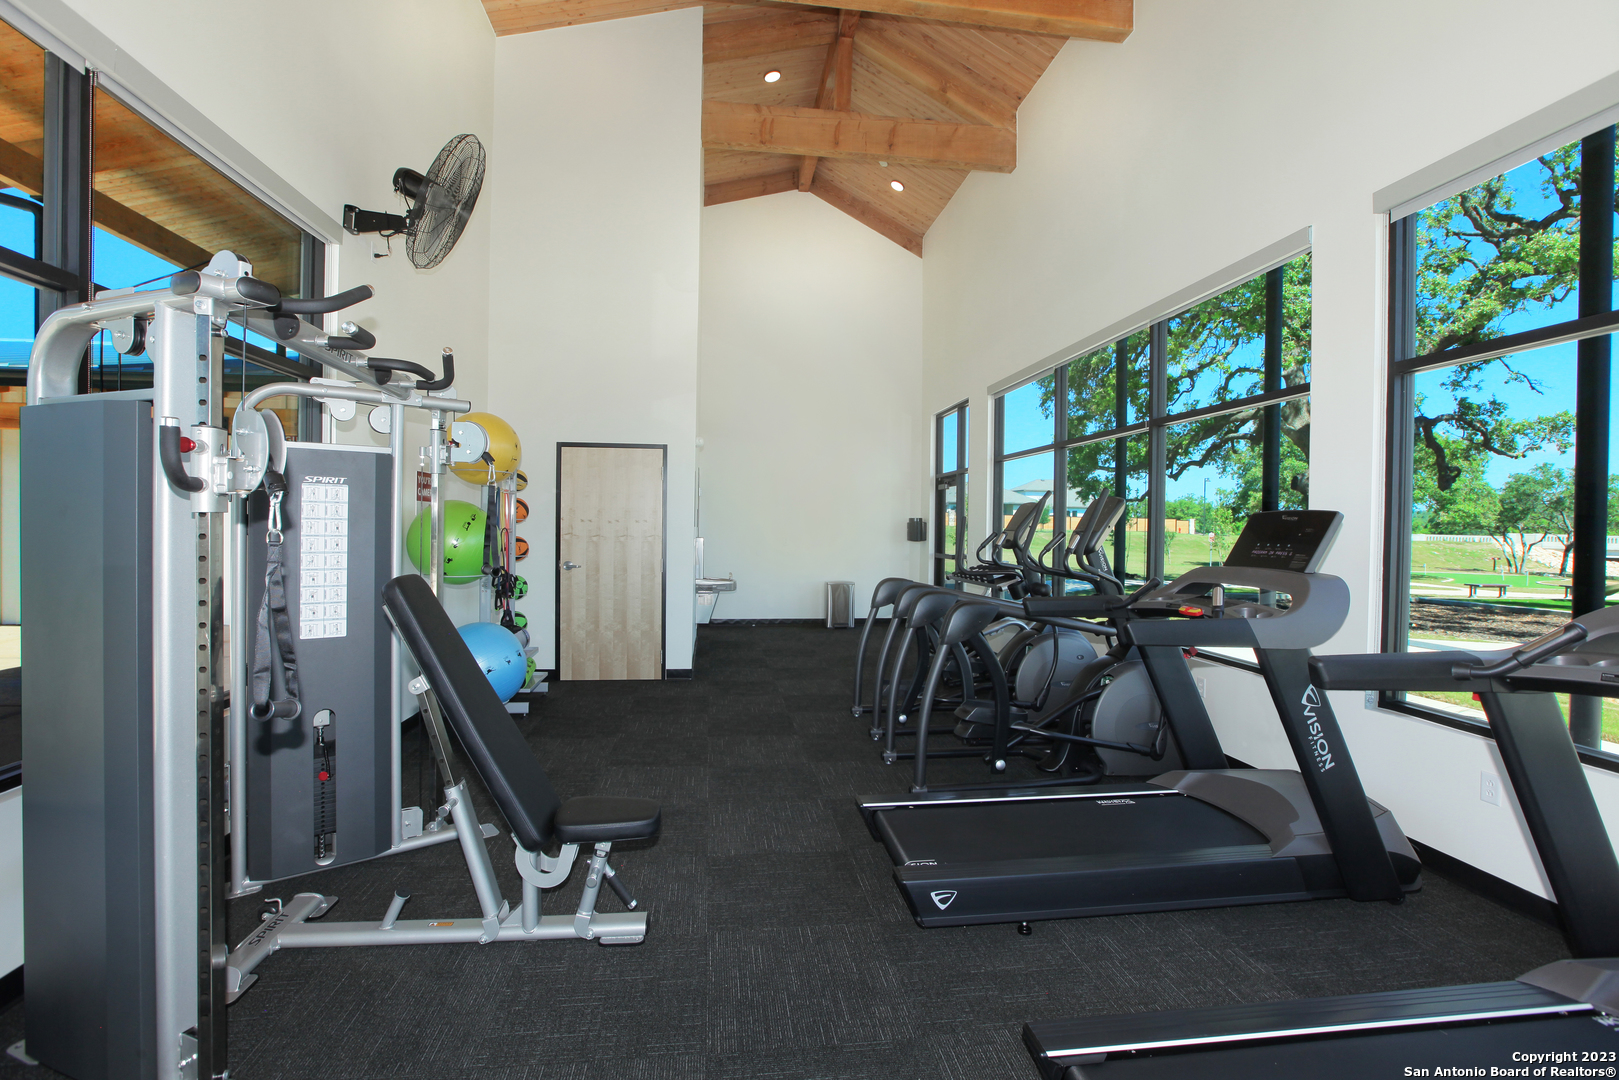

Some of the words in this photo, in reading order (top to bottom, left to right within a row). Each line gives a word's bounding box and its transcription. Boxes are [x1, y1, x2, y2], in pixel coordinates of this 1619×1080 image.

[325, 347, 353, 363] SPIRIT
[303, 475, 348, 484] SPIRIT
[417, 475, 431, 485] YOU'R
[417, 487, 431, 497] CAME
[1303, 706, 1335, 770] VISION
[1308, 736, 1325, 773] FITNESS
[248, 911, 290, 947] SPIRIT
